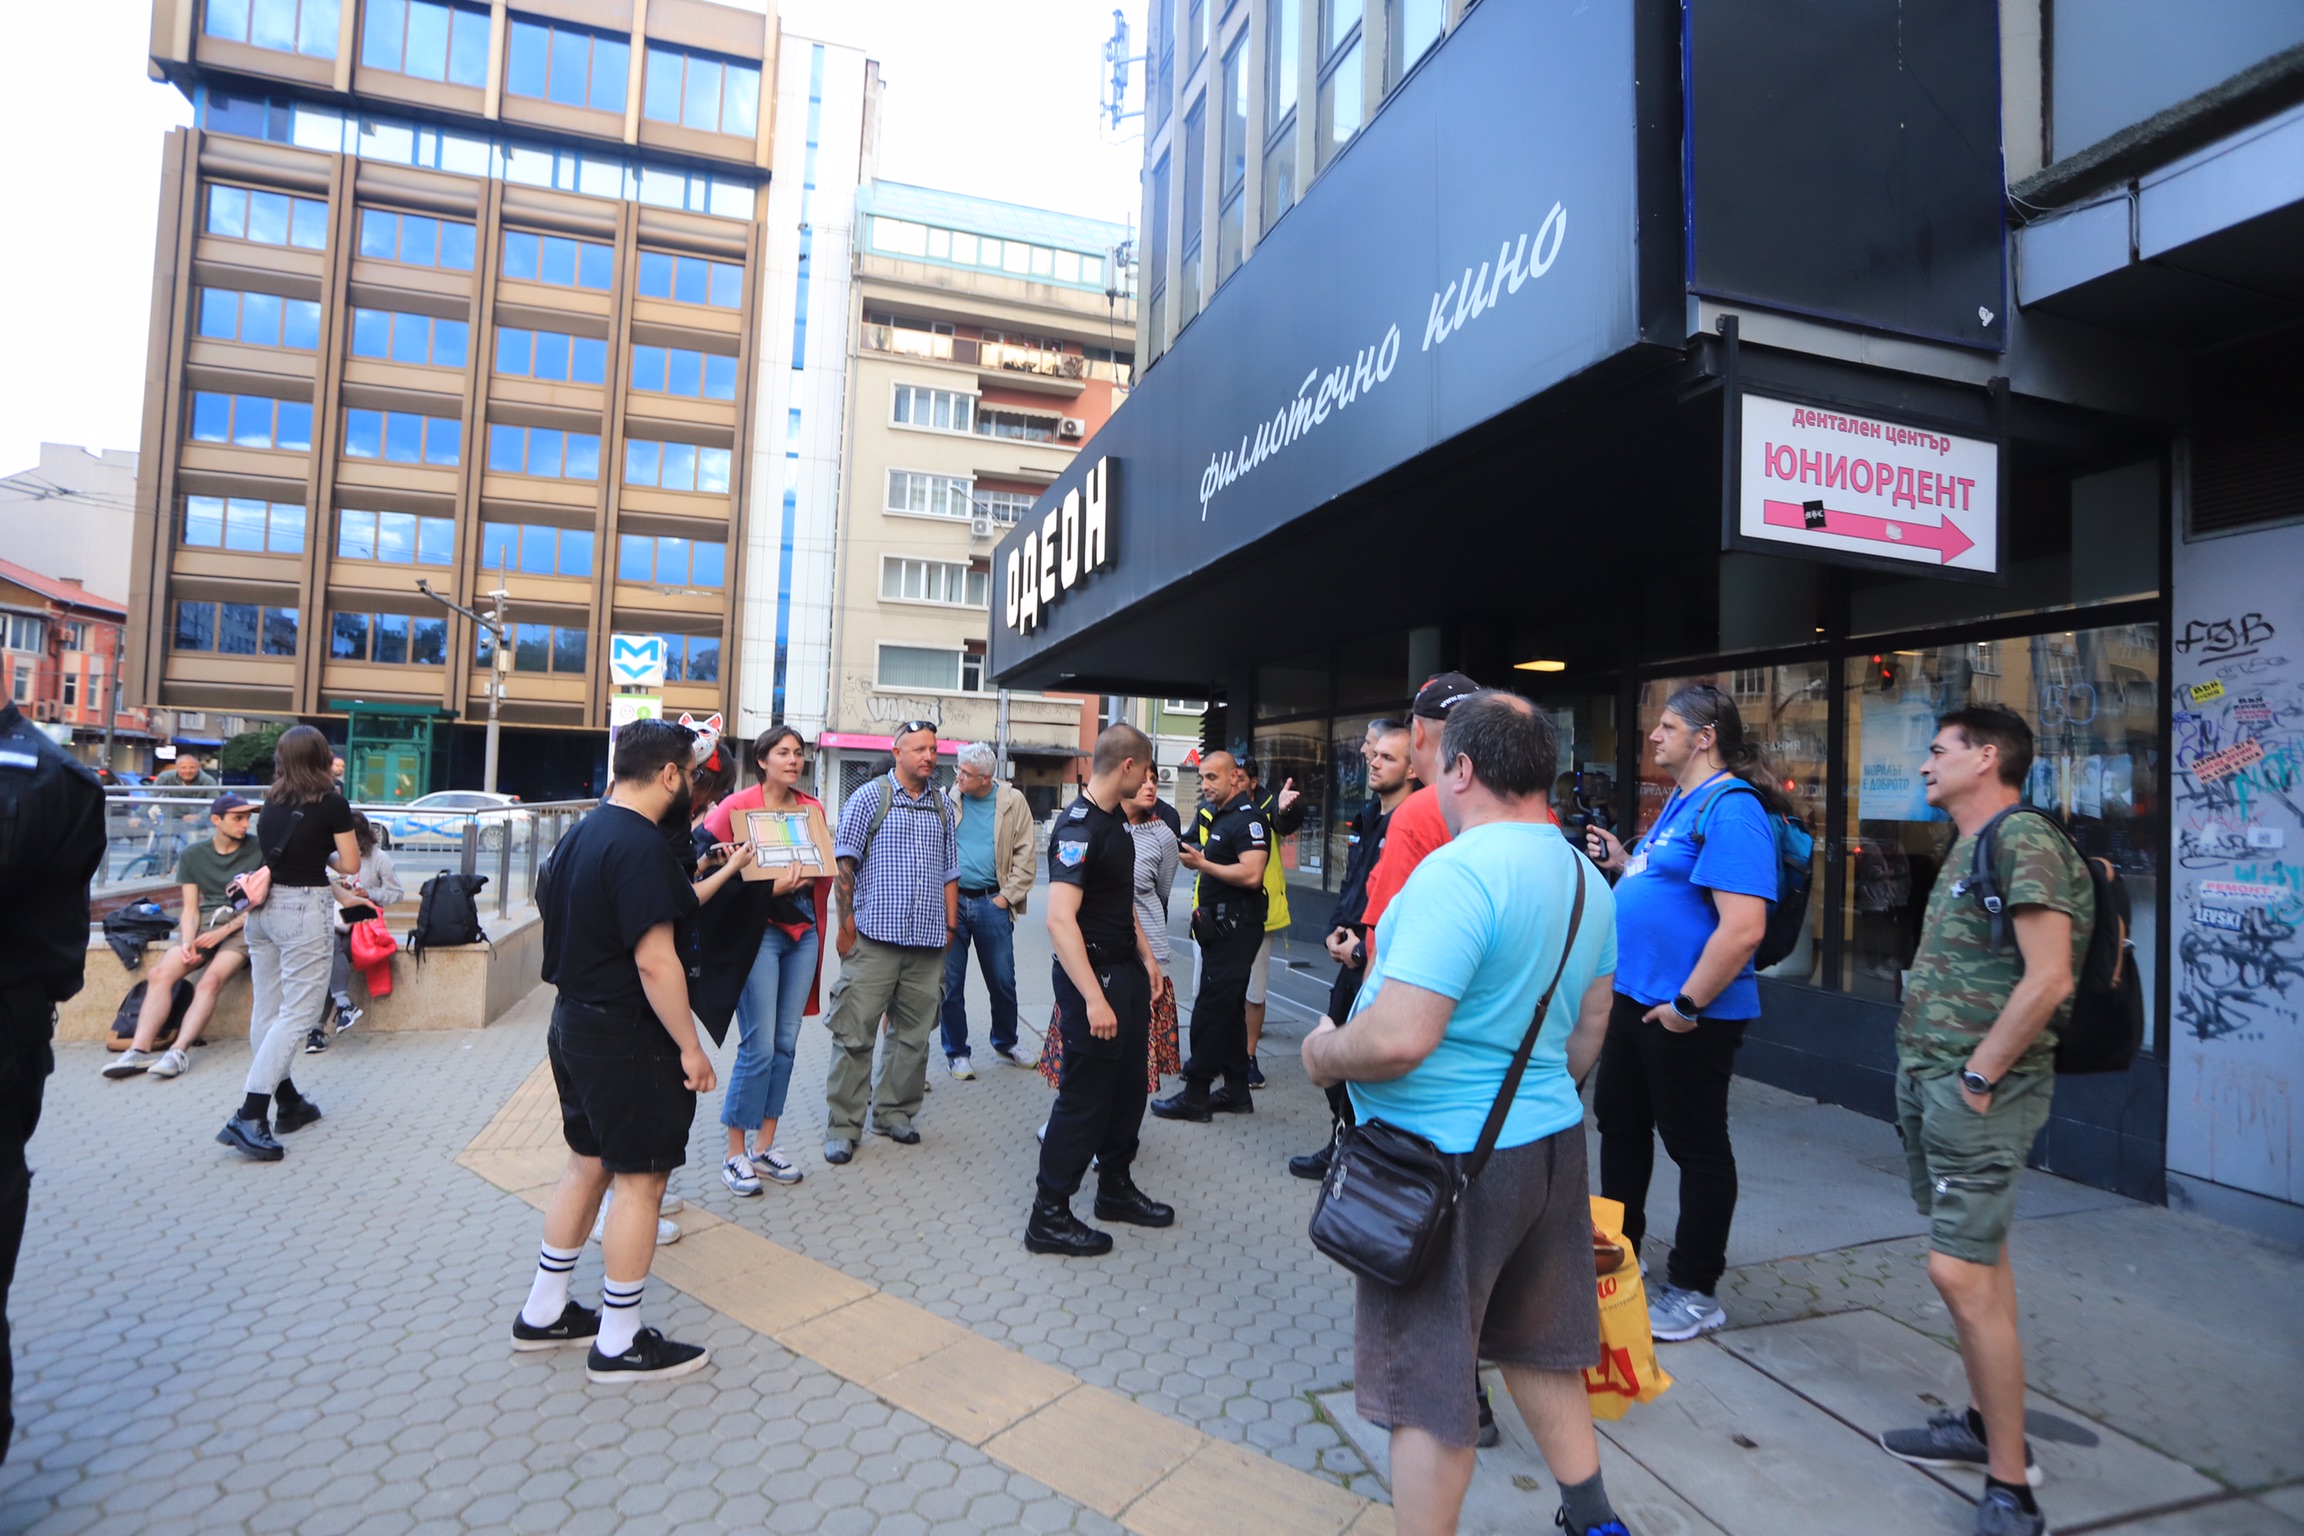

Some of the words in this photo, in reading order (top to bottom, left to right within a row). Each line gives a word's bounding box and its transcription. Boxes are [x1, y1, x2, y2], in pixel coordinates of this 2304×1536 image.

[1199, 322, 1401, 522] филмотечно
[1421, 200, 1567, 352] кино
[1792, 407, 1881, 439] дентален
[1885, 425, 1951, 457] център
[1764, 442, 1976, 512] ЮНИОРДЕНТ
[1006, 455, 1107, 636] ОДЕОН
[1863, 764, 1902, 777] МОРАЛЪТ
[1869, 779, 1910, 791] ДОБРОТО
[2206, 882, 2271, 894] РЕМОНТ
